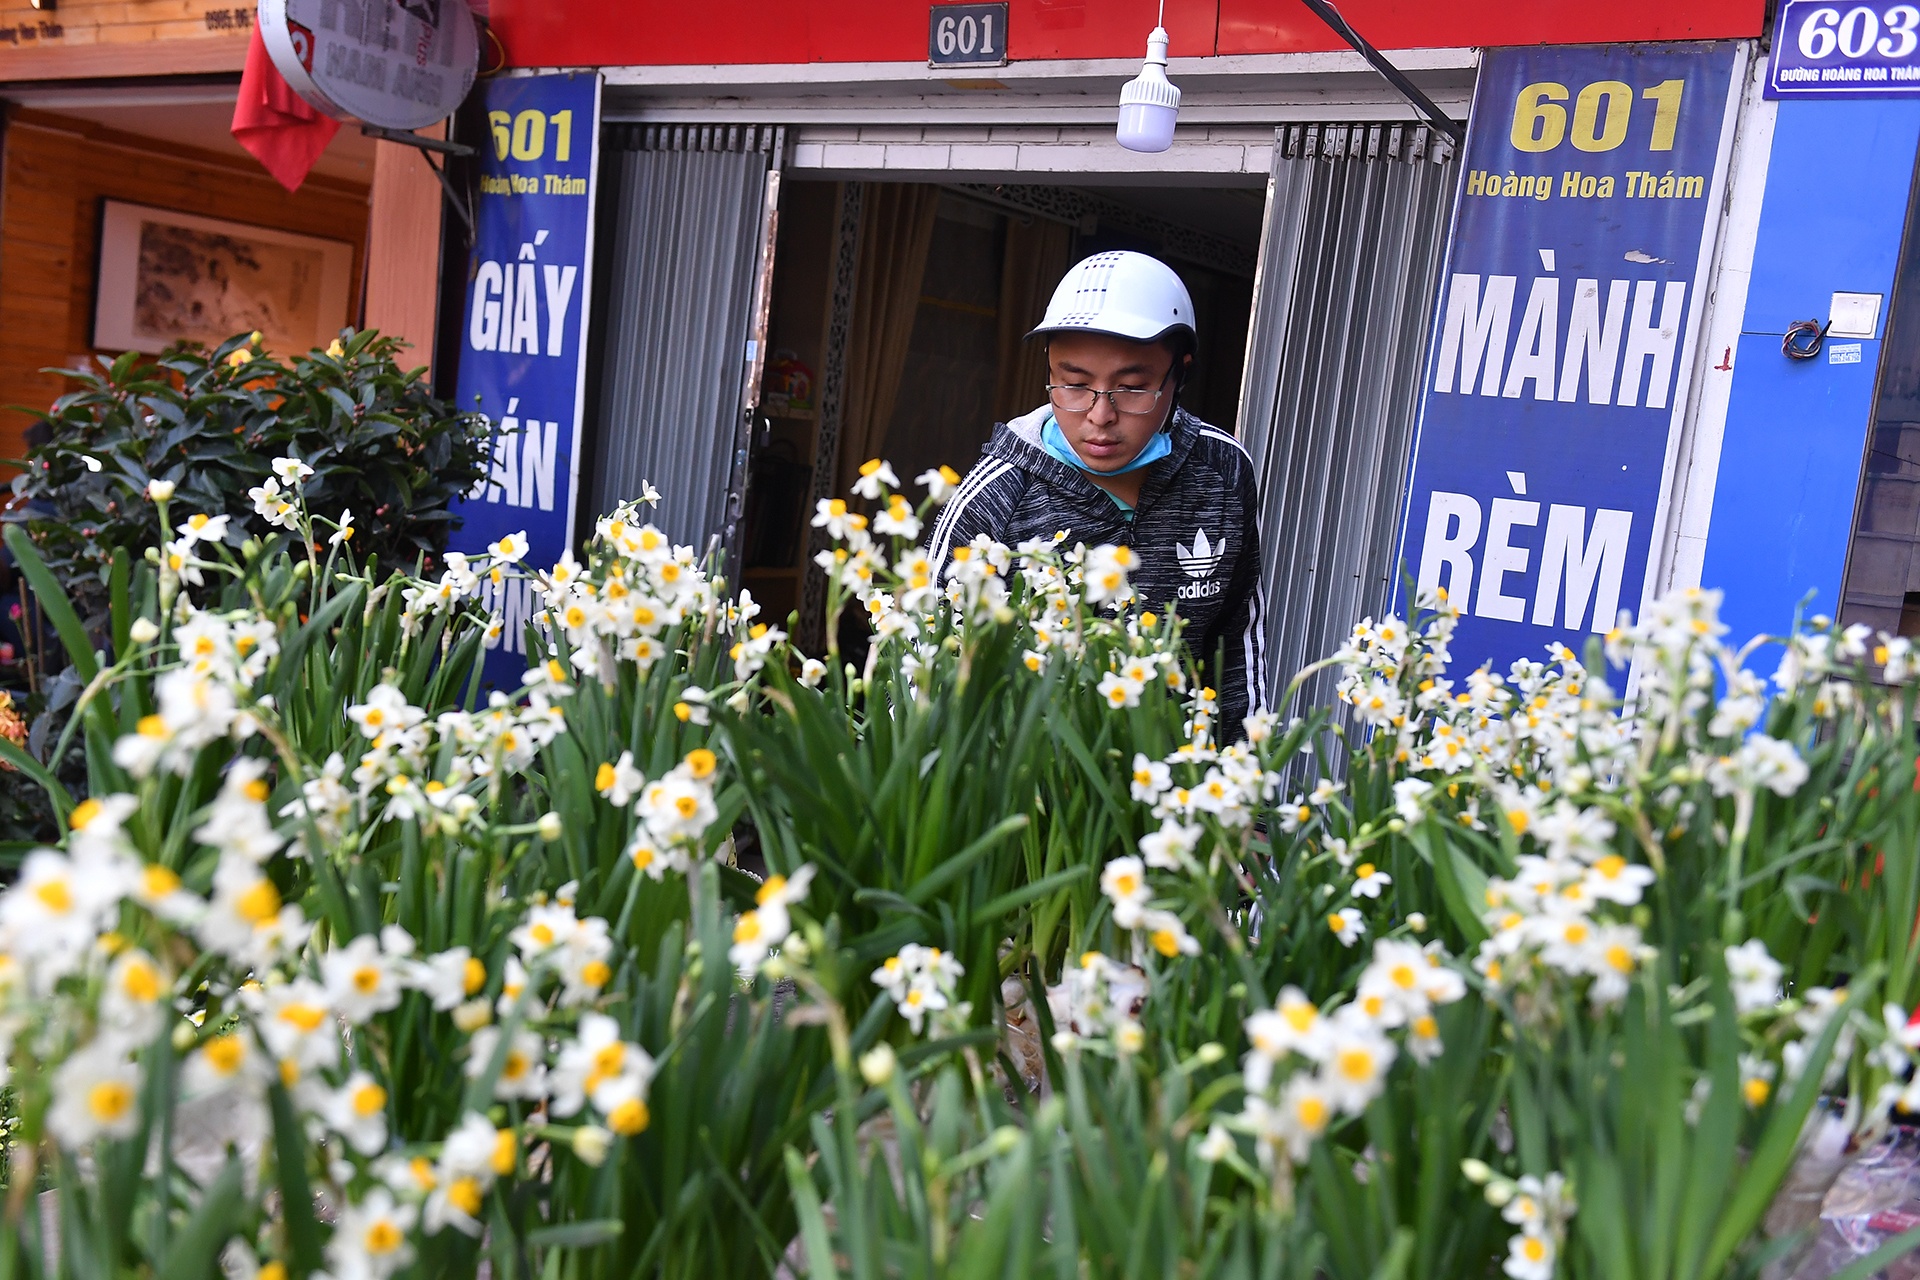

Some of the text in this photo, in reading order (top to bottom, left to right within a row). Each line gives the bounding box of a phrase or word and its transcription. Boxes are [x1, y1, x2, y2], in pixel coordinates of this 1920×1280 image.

[937, 14, 995, 55] 601
[1797, 5, 1920, 59] 603
[1780, 66, 1820, 82] ĐƯỜNG
[1821, 66, 1861, 81] HOÀNG
[1864, 67, 1888, 81] HOA
[488, 109, 573, 162] 601
[1510, 79, 1685, 153] 601
[510, 173, 539, 195] Hoa
[543, 174, 586, 195] Thám
[1466, 170, 1705, 201] Hoàng Hoa Thám
[469, 230, 577, 357] GIẤY
[1433, 249, 1686, 408] MÀNH
[1414, 471, 1633, 635] RÈM
[1177, 580, 1220, 599] adidas
